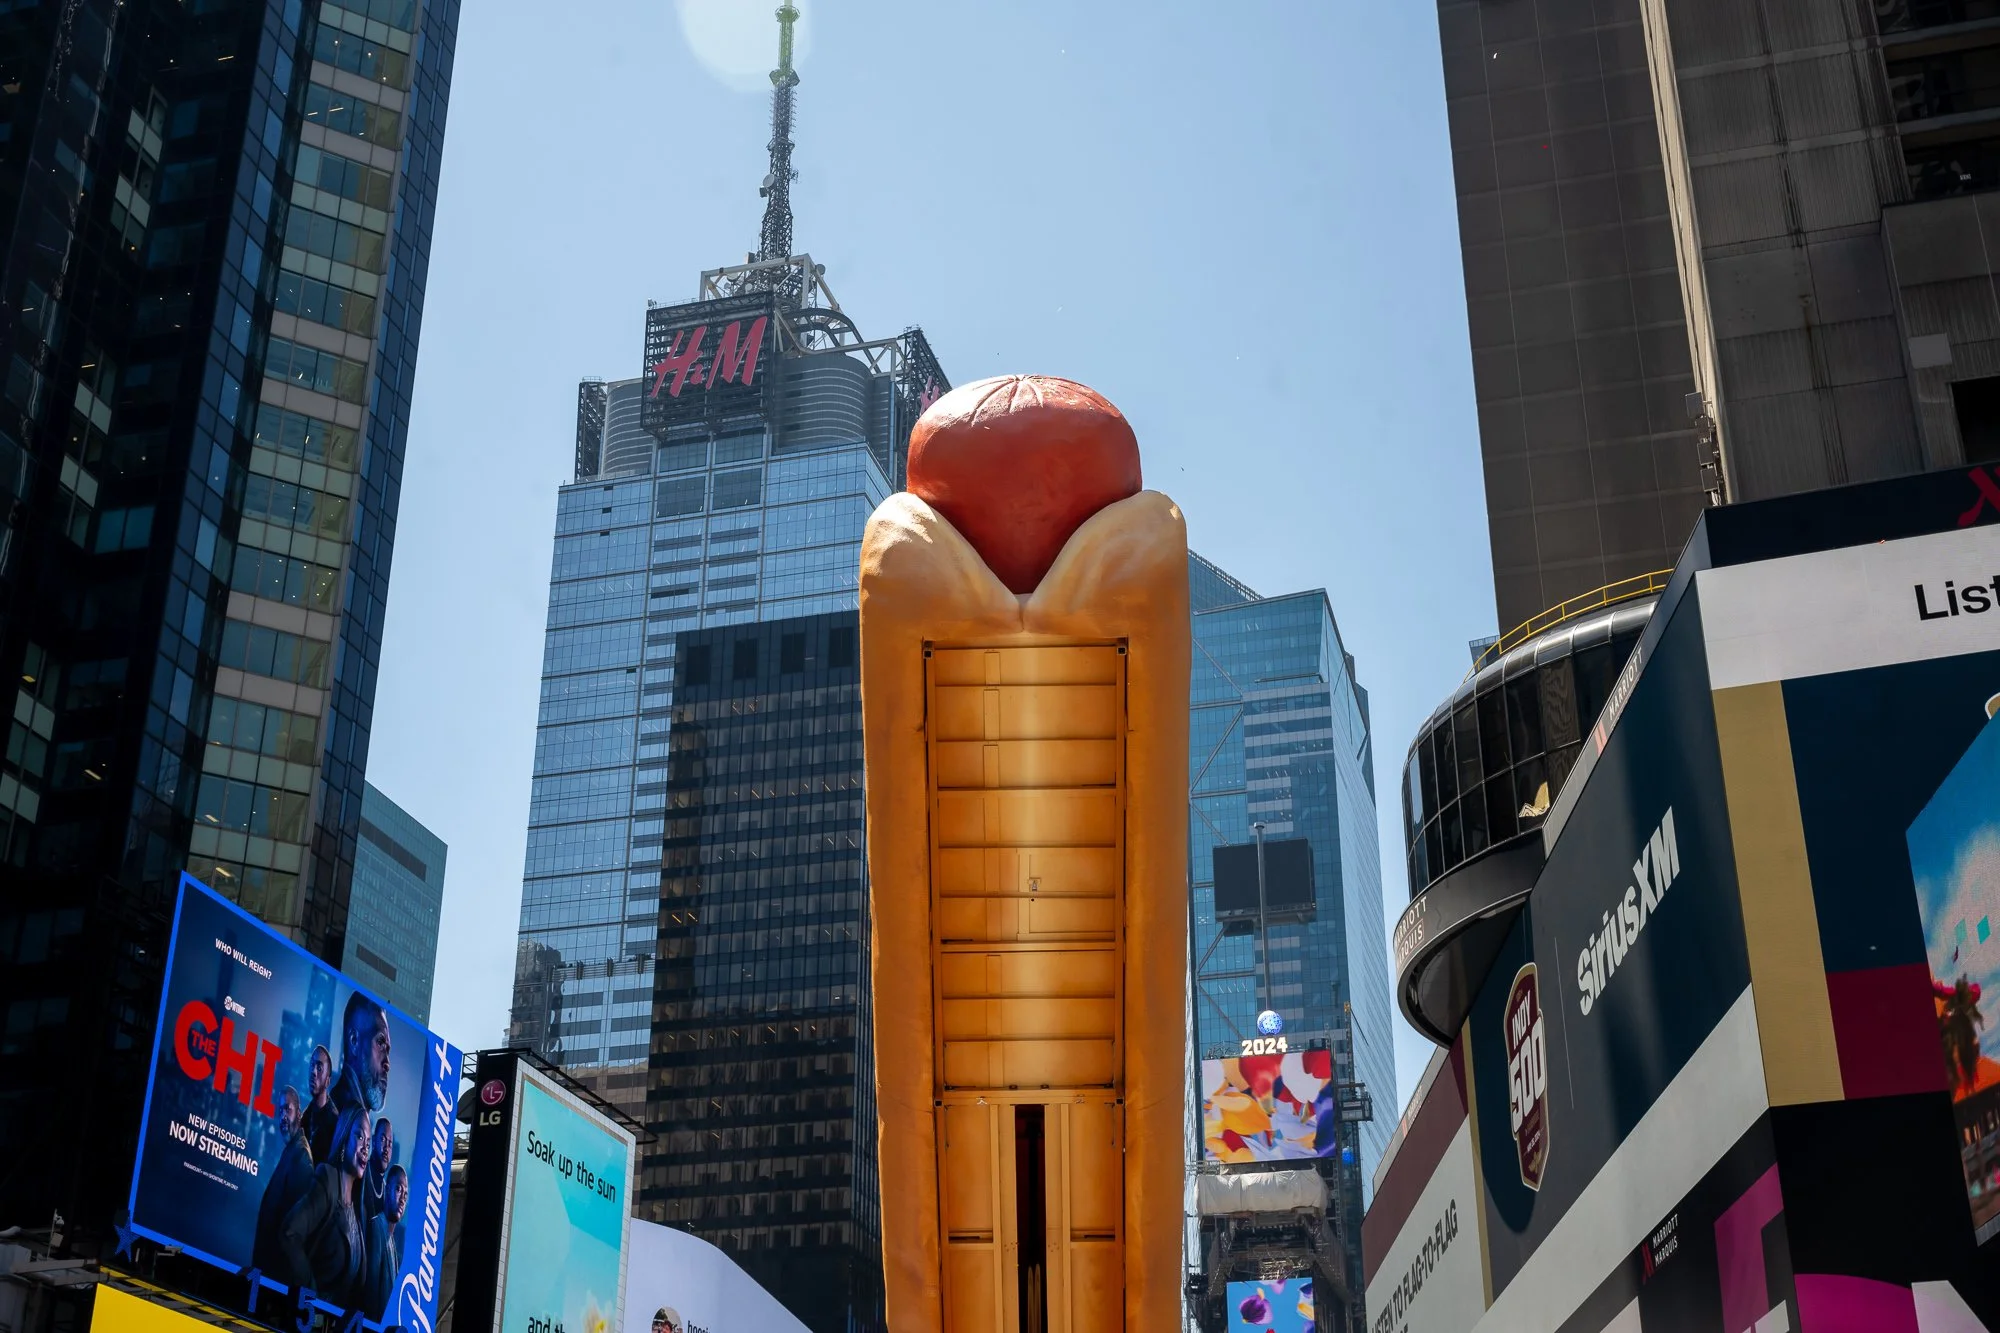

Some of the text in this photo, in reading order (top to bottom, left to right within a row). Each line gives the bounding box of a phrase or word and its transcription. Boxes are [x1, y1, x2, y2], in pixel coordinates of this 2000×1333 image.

[650, 316, 768, 398] H&M
[1609, 647, 1643, 721] MARRIOTT
[1577, 805, 1681, 1016] SiriusXM
[215, 938, 272, 980] WHO WILL REIGN?
[190, 1029, 217, 1058] THE
[1241, 1036, 1288, 1056] 2024
[1512, 990, 1531, 1051] INDY
[174, 1000, 283, 1119] CHI
[1510, 1016, 1546, 1134] 500
[169, 1120, 259, 1177] NOW STREAMING
[188, 1113, 247, 1150] NEW EPISODES
[479, 1110, 501, 1126] LG
[399, 1041, 453, 1333] Paramount+
[526, 1130, 616, 1203] Soak up the sun
[1652, 1213, 1678, 1249] MARRIOTT
[1654, 1235, 1678, 1267] MARQUIS
[1371, 1299, 1394, 1333] STEN
[1393, 1285, 1403, 1325] TO
[1403, 1198, 1459, 1311] FLAG-TO-FLAG
